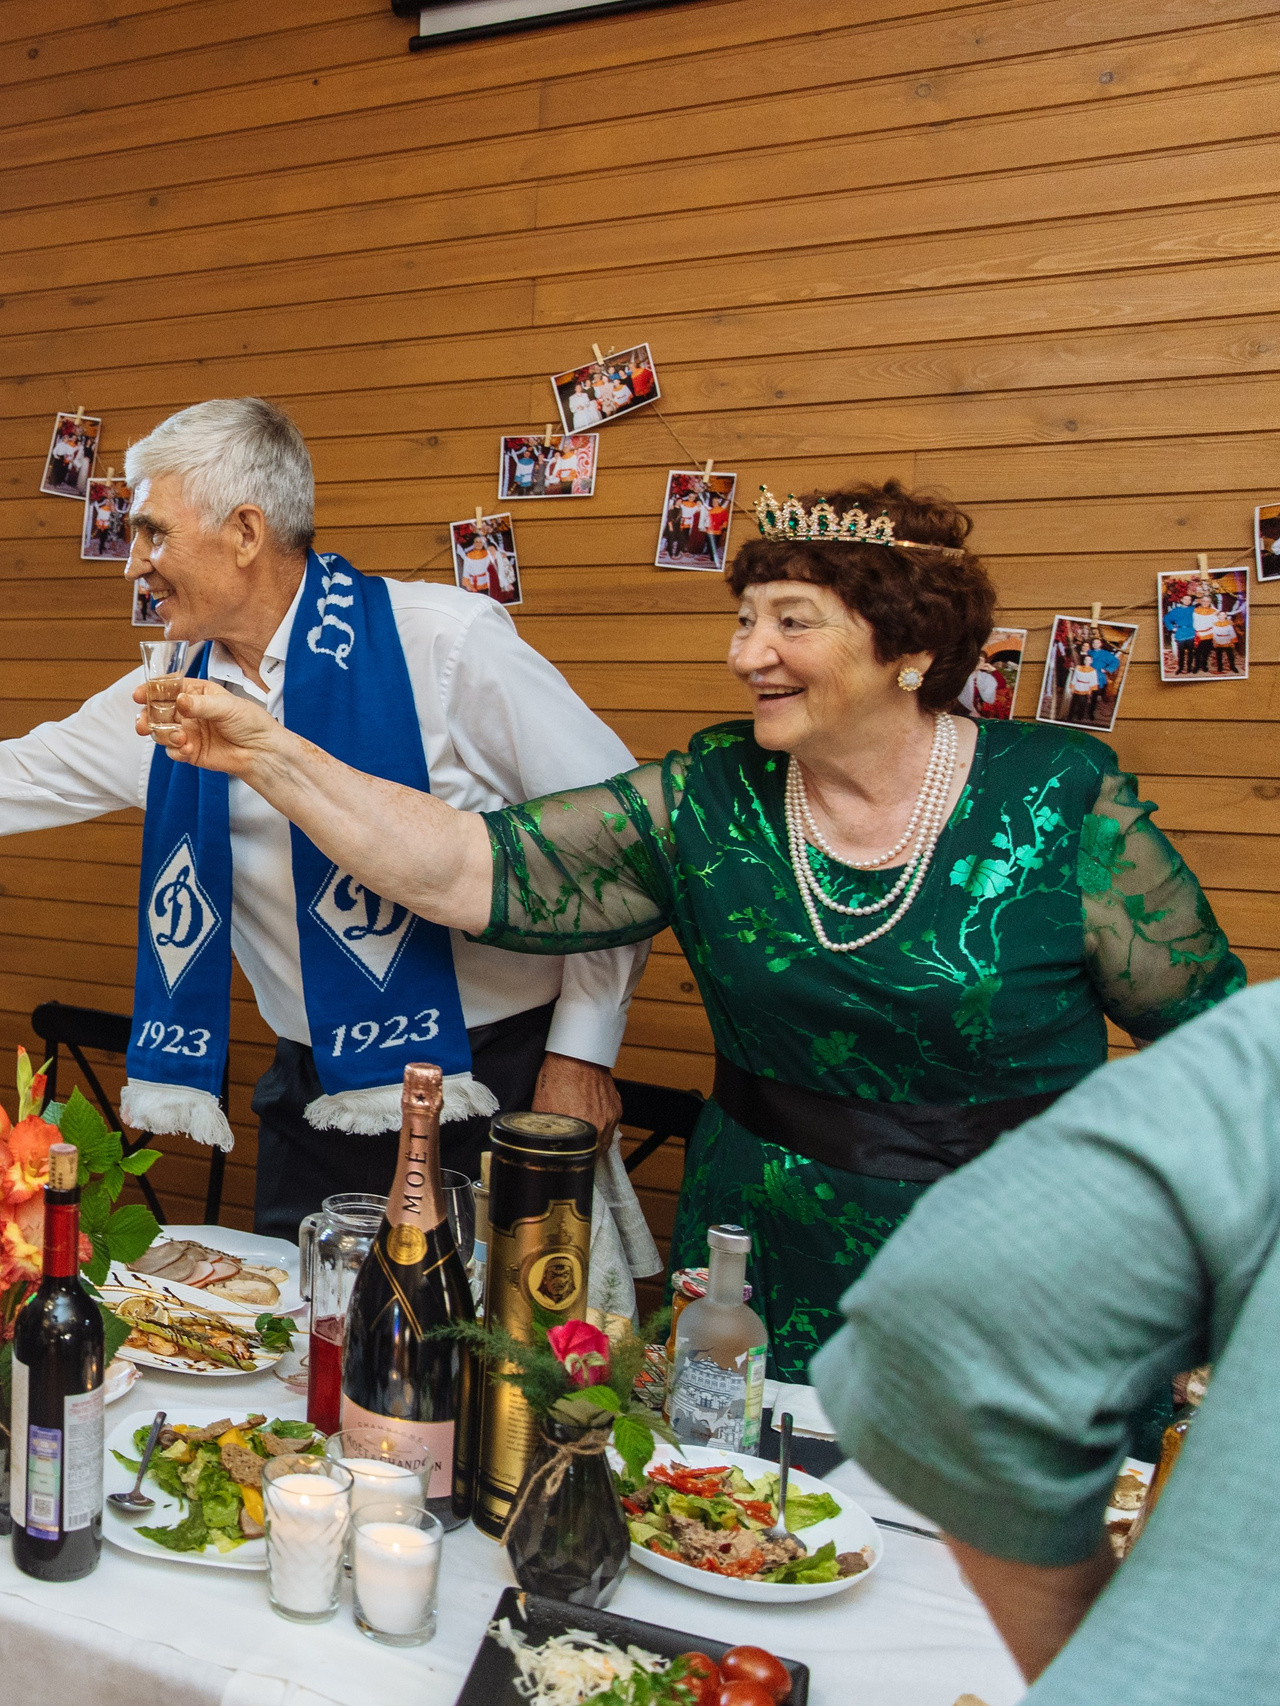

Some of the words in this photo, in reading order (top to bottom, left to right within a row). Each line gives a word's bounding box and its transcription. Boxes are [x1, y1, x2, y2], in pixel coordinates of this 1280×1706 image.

[136, 1020, 211, 1057] 1923
[331, 1008, 440, 1057] 1923
[402, 1128, 428, 1215] MOËT
[357, 1421, 424, 1443] CHAMPAGNE
